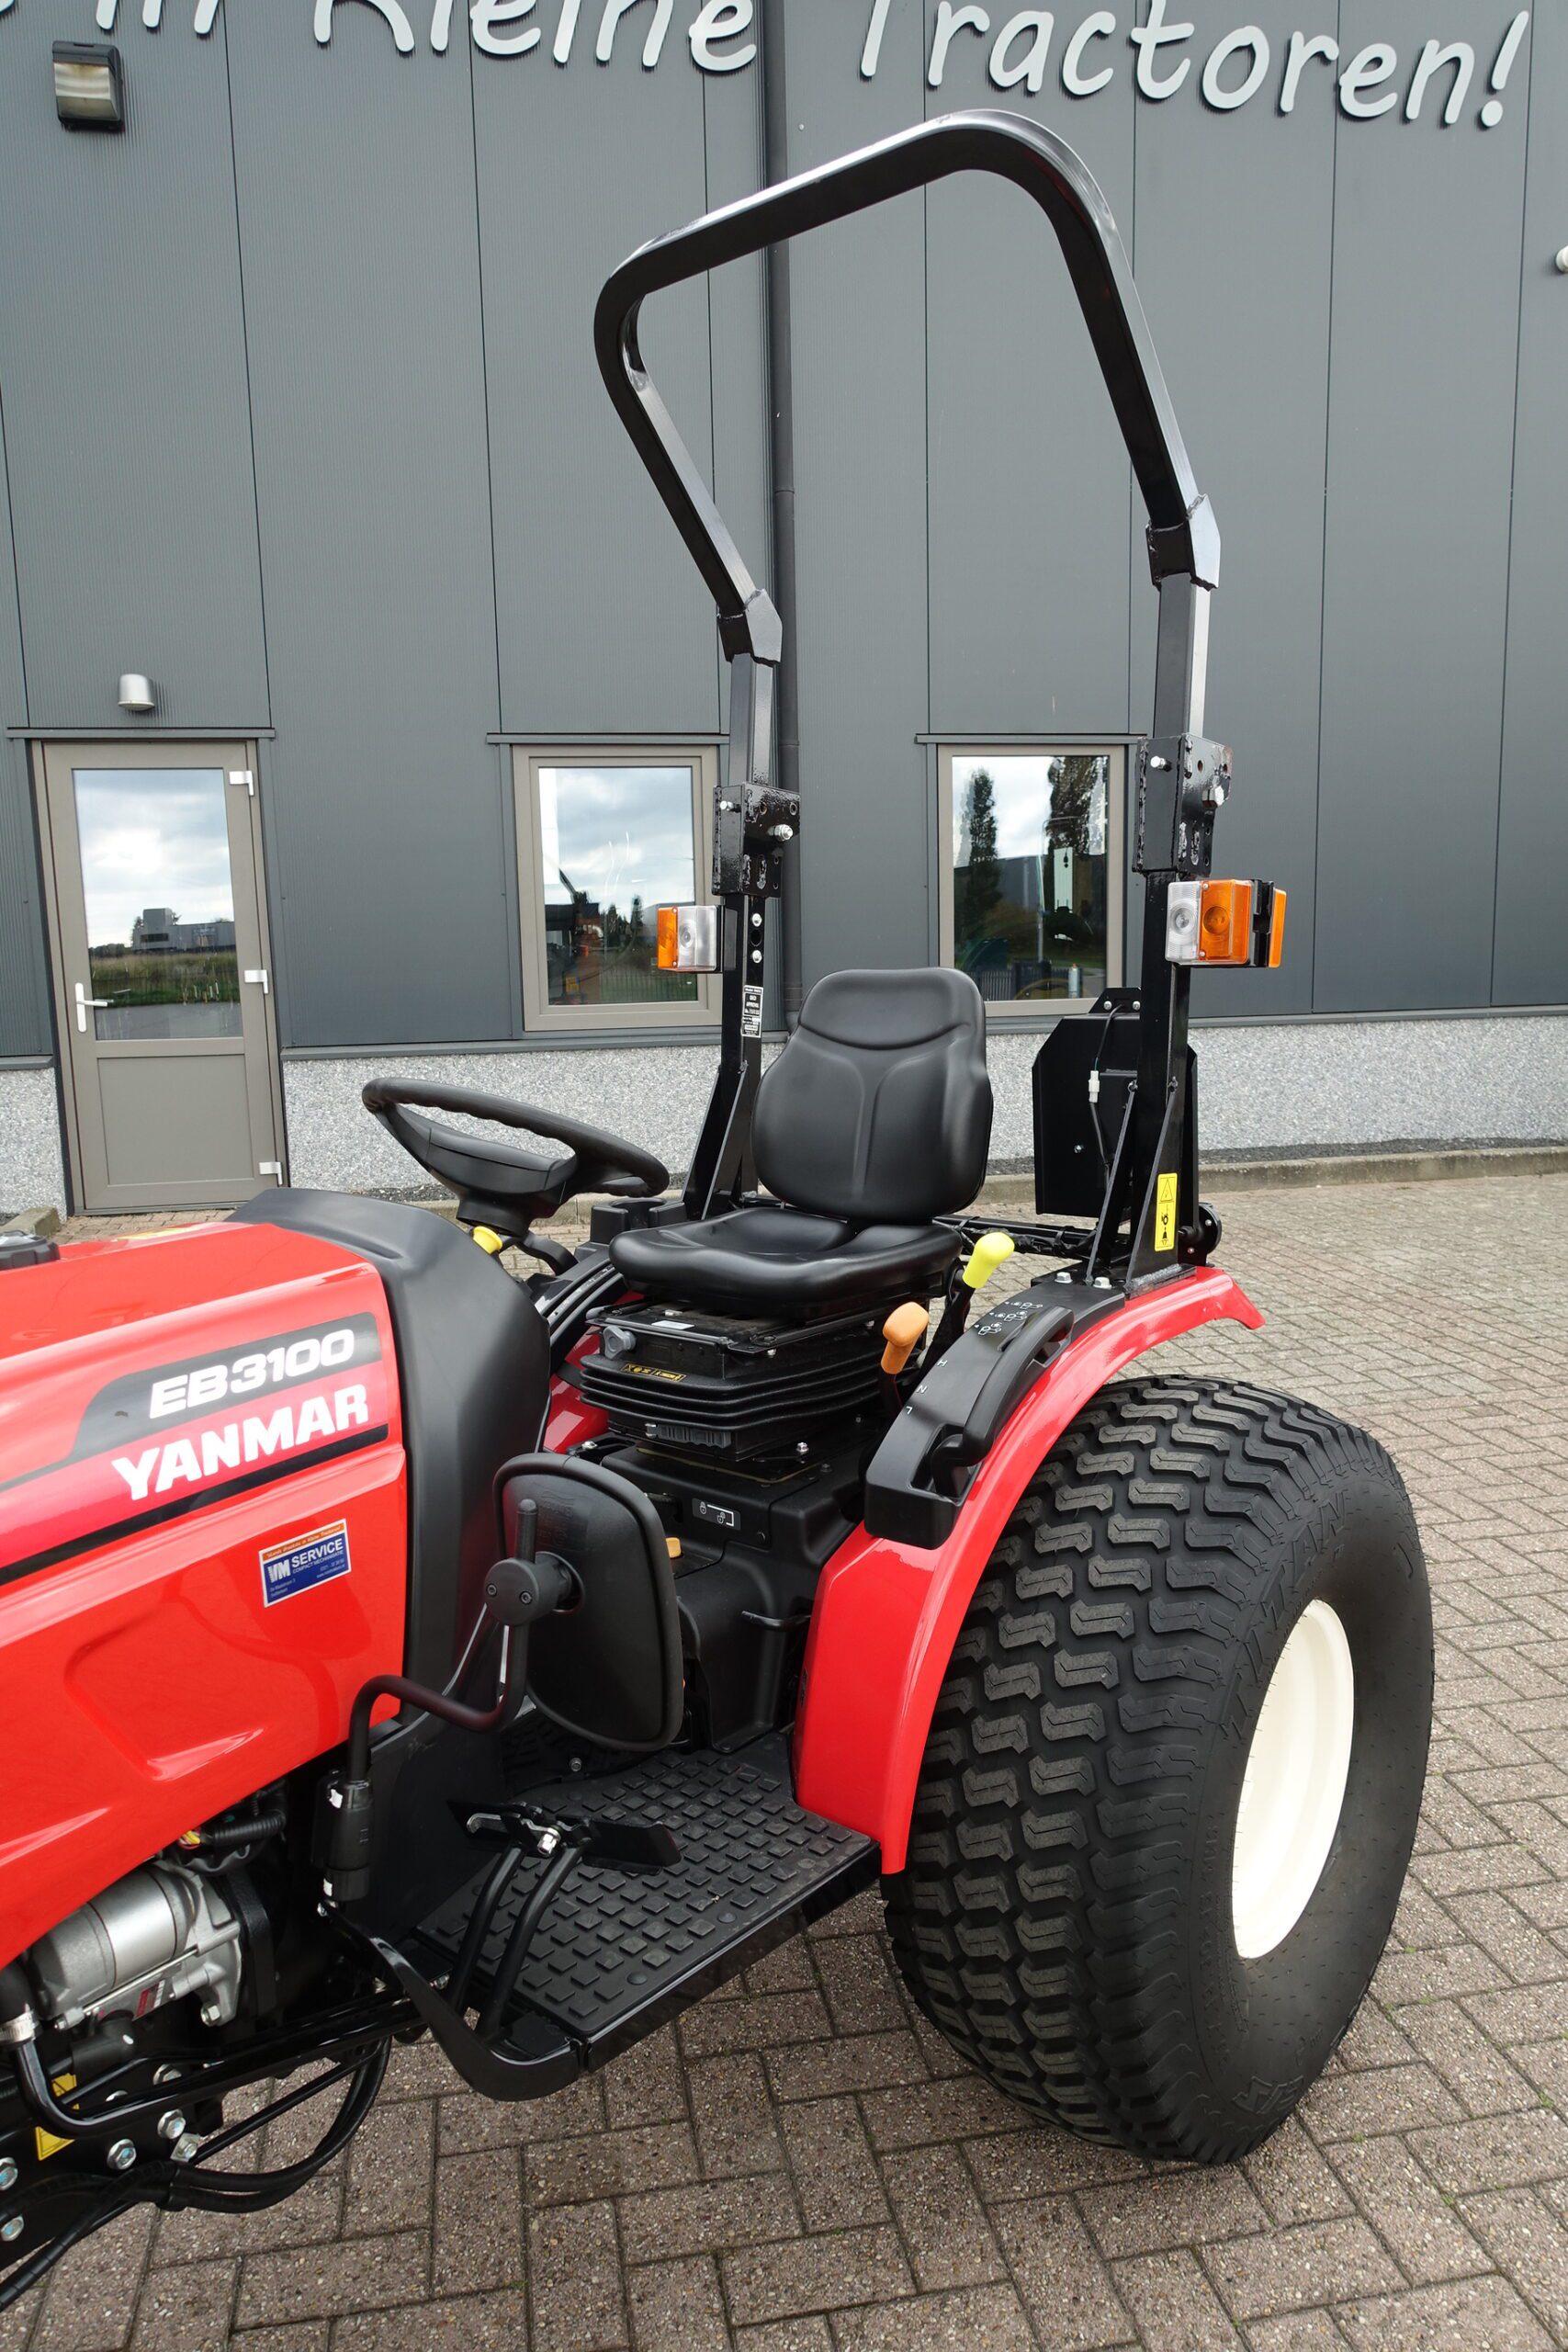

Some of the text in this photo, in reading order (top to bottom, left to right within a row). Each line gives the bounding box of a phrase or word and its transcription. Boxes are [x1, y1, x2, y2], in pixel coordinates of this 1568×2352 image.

[150, 1329, 355, 1419] EB3100
[937, 1359, 948, 1367] H
[111, 1384, 368, 1501] YANMAR
[291, 1538, 344, 1568] SERVICE
[292, 1562, 313, 1574] COMPACT
